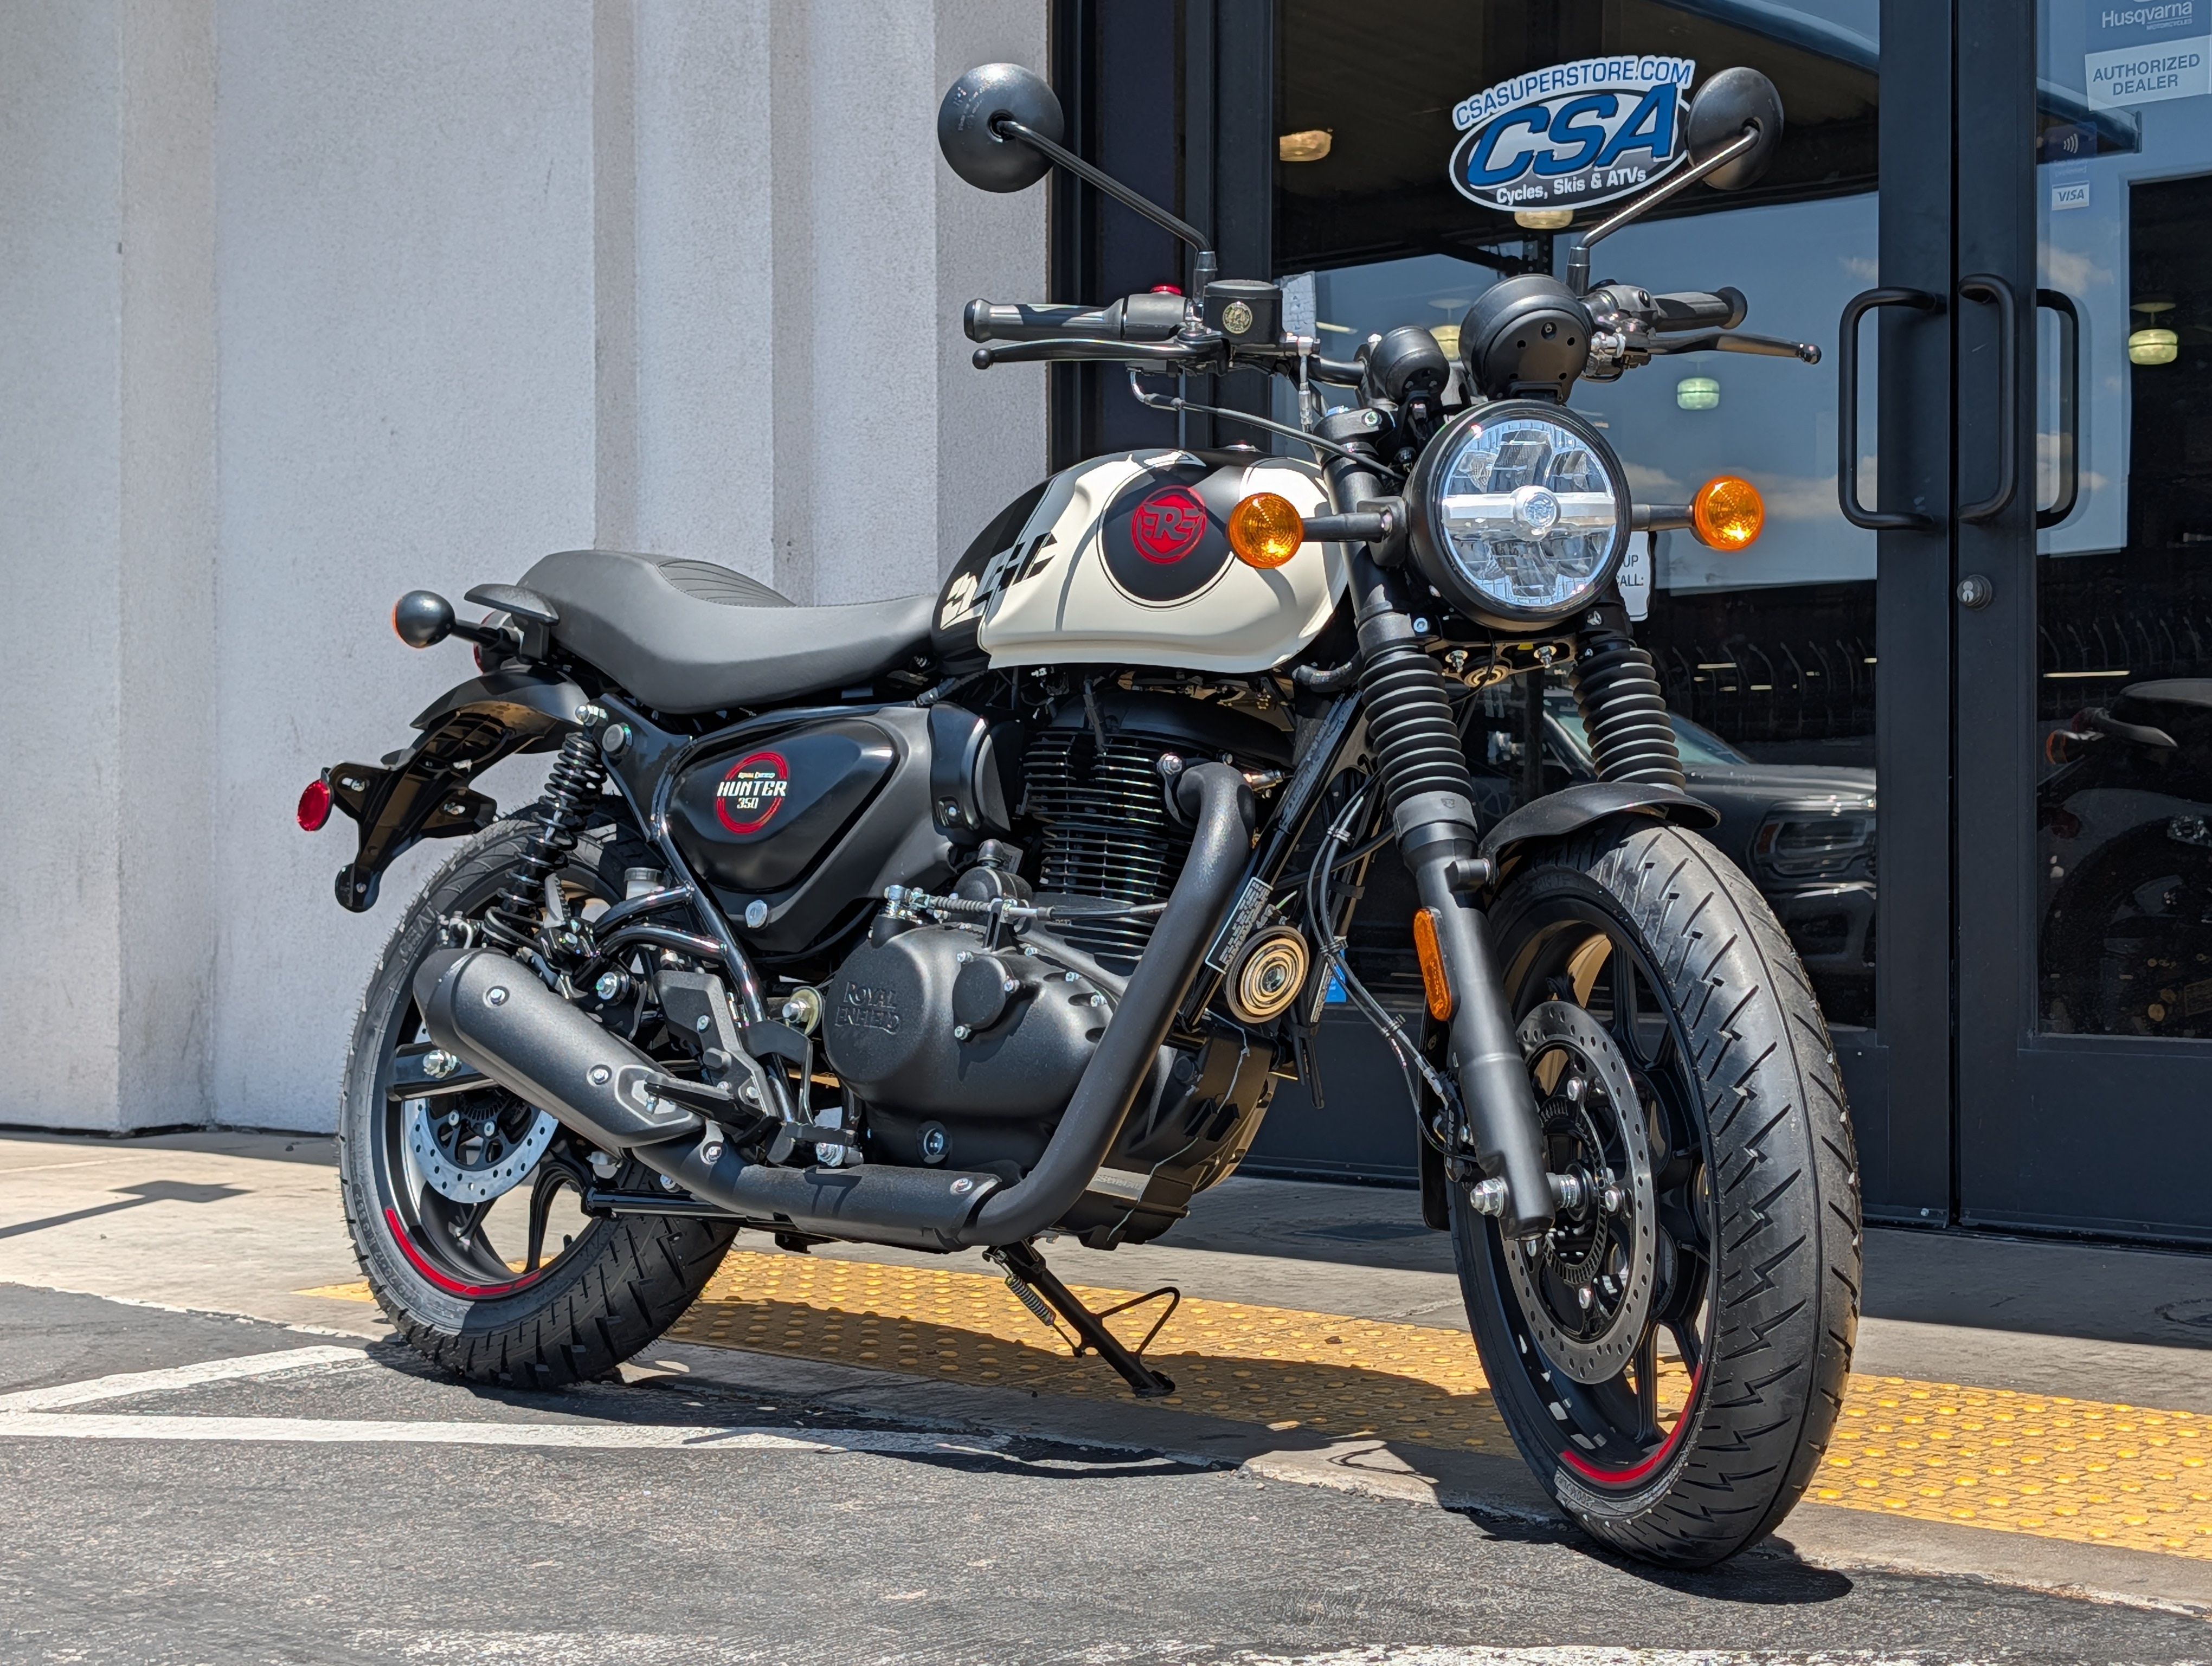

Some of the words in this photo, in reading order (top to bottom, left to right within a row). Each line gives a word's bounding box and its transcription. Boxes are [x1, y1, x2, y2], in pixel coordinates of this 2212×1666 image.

[2102, 1, 2192, 28] Husqvarna
[2093, 53, 2200, 82] AUTHORIZED
[1456, 60, 1691, 127] CSASUPERSTORE.COM
[2113, 74, 2178, 96] DEALER
[1467, 82, 1677, 185] CSA
[1496, 184, 1548, 206] Cycles,
[1553, 176, 1585, 195] Skis
[1591, 173, 1602, 189] &
[1606, 166, 1647, 187] ATVs
[2057, 188, 2085, 202] VISA
[1623, 554, 1638, 568] UP
[1616, 573, 1644, 586] ALL:
[717, 781, 787, 797] HUNTER
[736, 797, 759, 809] 350
